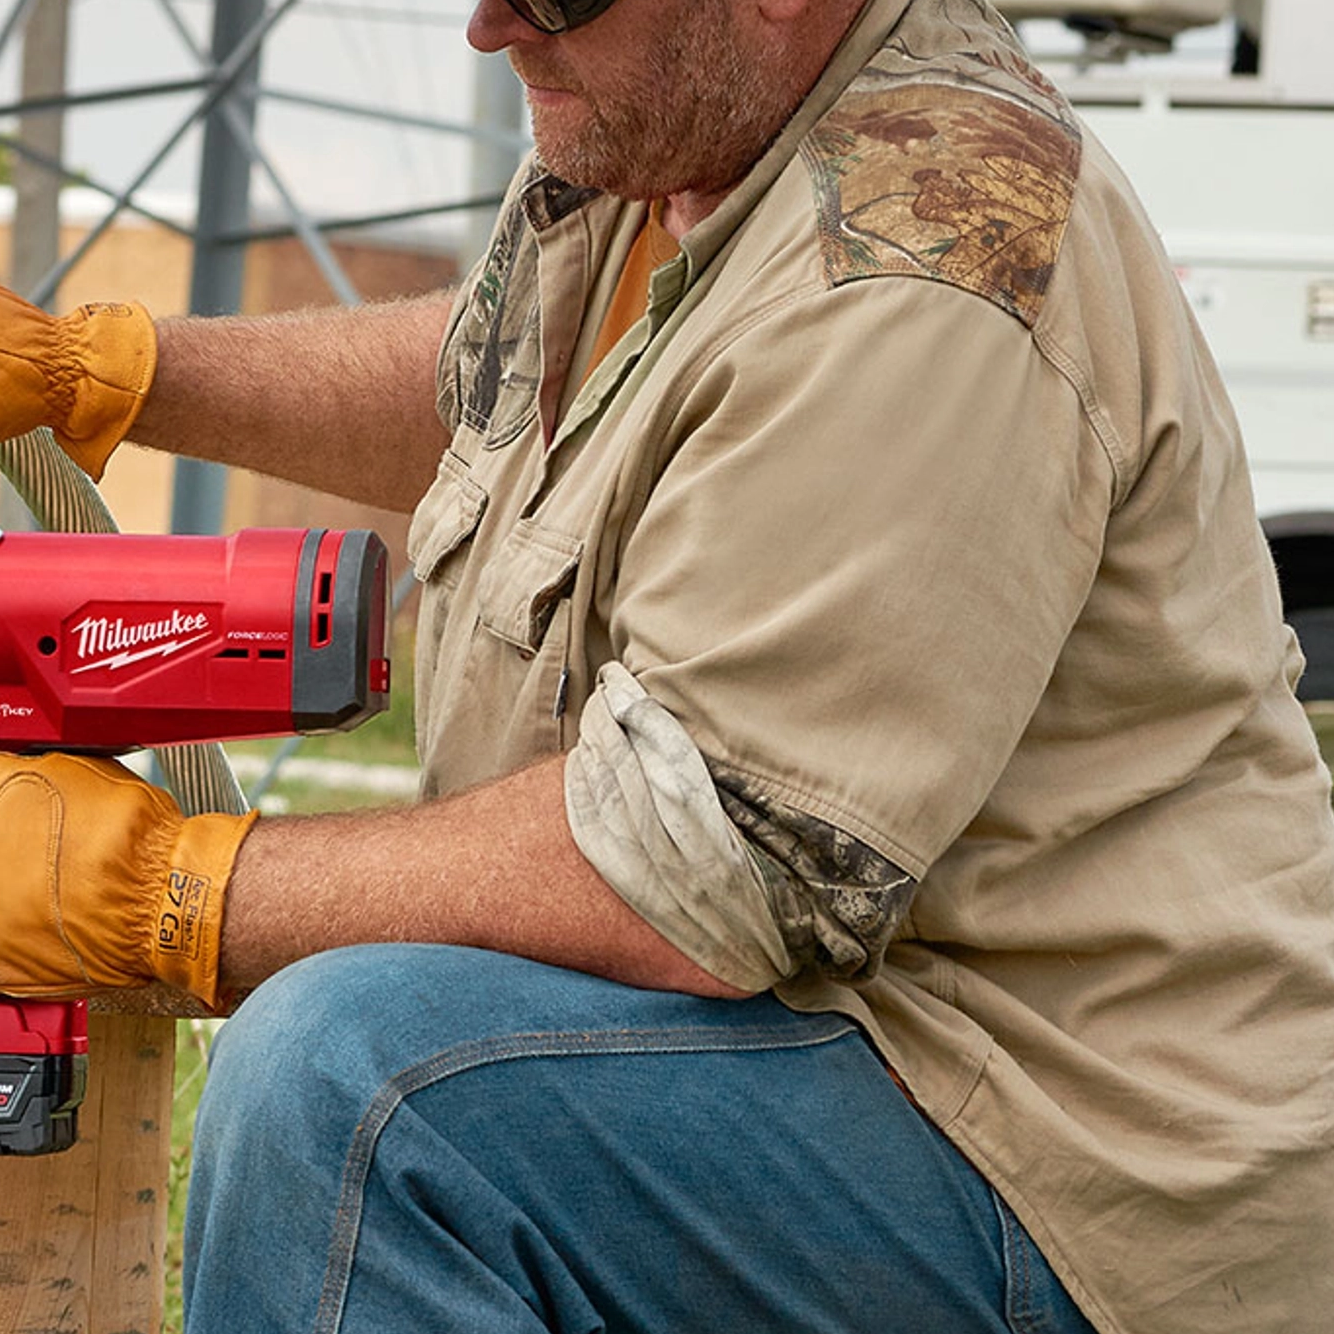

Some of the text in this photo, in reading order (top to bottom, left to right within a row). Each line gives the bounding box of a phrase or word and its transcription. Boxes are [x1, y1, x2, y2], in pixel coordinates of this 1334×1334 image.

[70, 609, 209, 659] Milwaukee
[159, 872, 188, 950] 27 Cal
